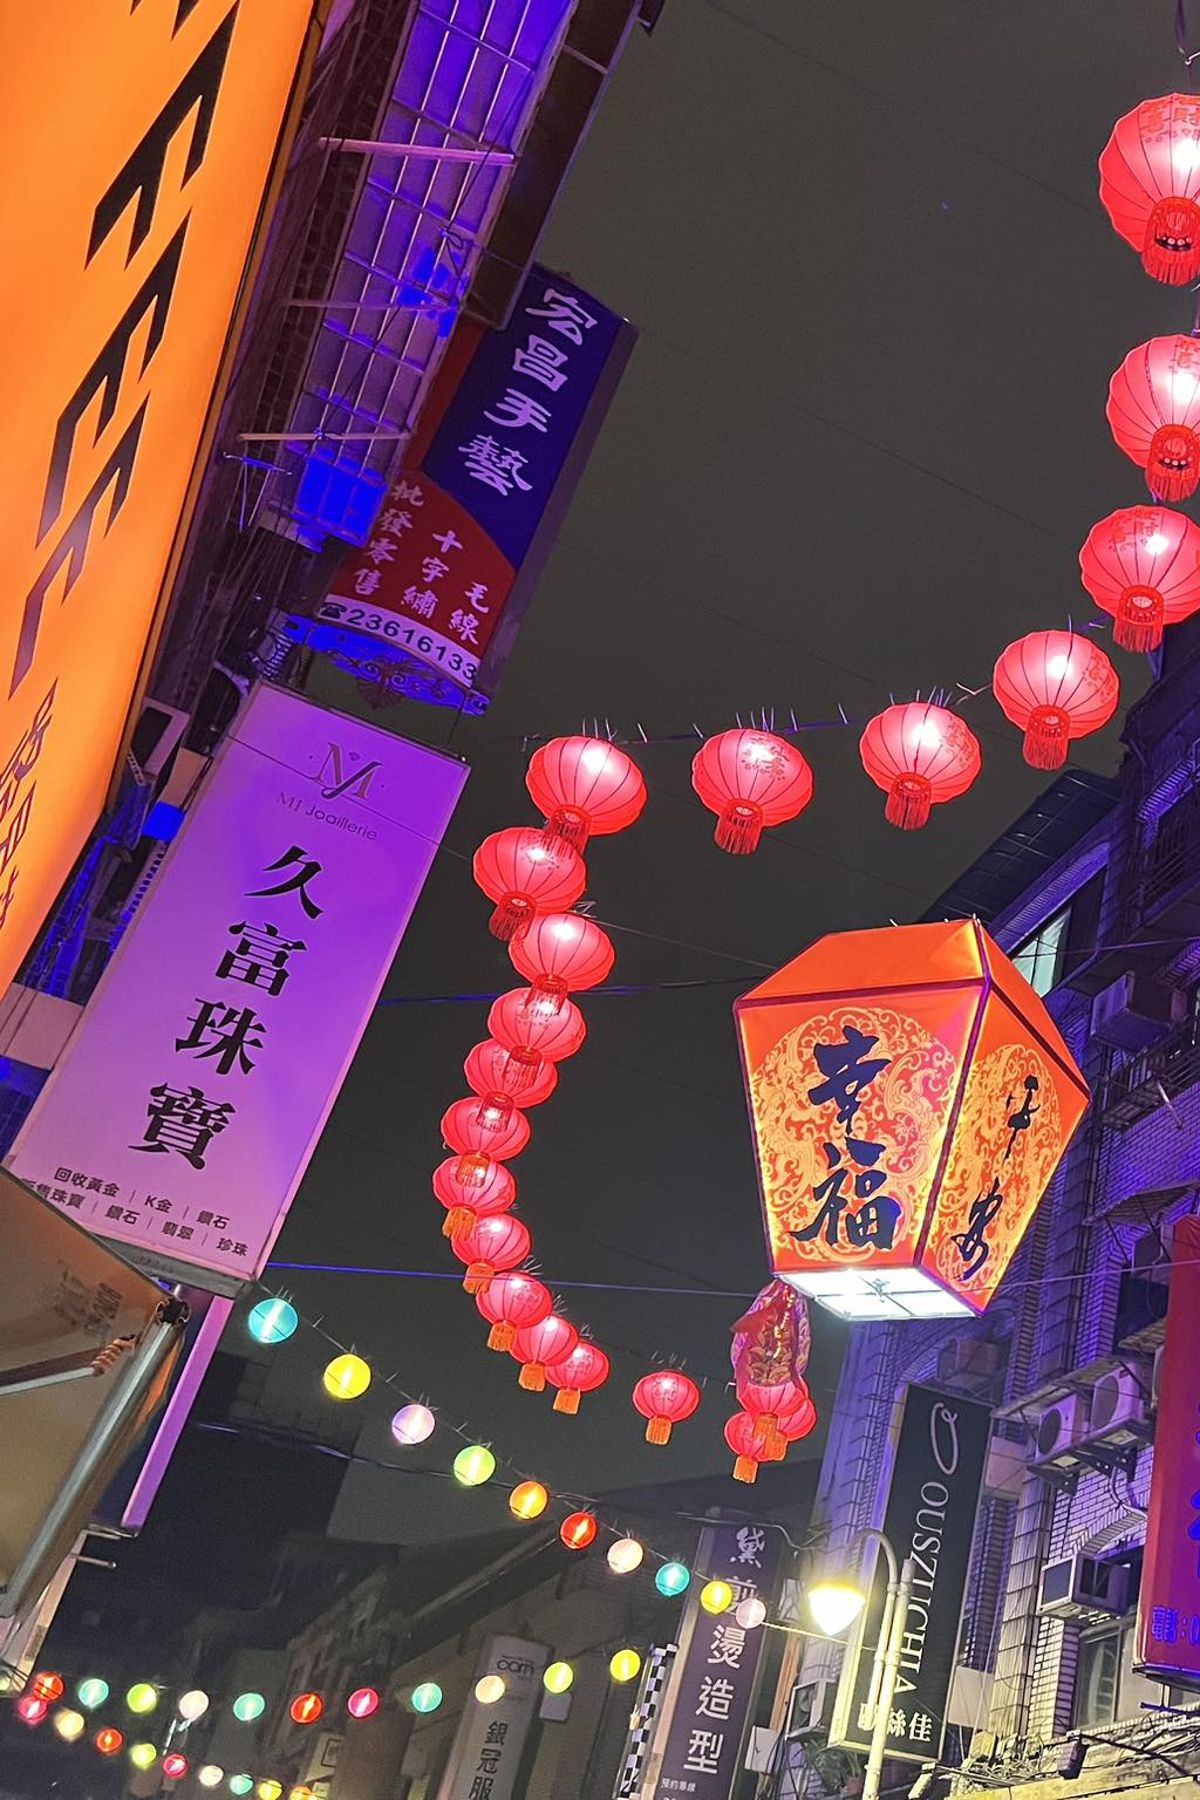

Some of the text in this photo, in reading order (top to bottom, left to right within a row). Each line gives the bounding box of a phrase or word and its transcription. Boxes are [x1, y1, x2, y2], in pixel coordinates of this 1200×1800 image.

[353, 480, 425, 596] 批發零售
[401, 530, 465, 619] 十字繡
[346, 608, 478, 682] 23616133
[448, 581, 490, 645] 毛線
[304, 805, 378, 841] Joaillerie
[128, 845, 325, 1171] 久富珠寶
[788, 1024, 903, 1250] 幸福
[54, 1167, 231, 1230] 回收黃金 K金 鑽石
[105, 1204, 141, 1226] 鑽石
[162, 1221, 195, 1241] 翡翠
[216, 1238, 249, 1257] 珍珠
